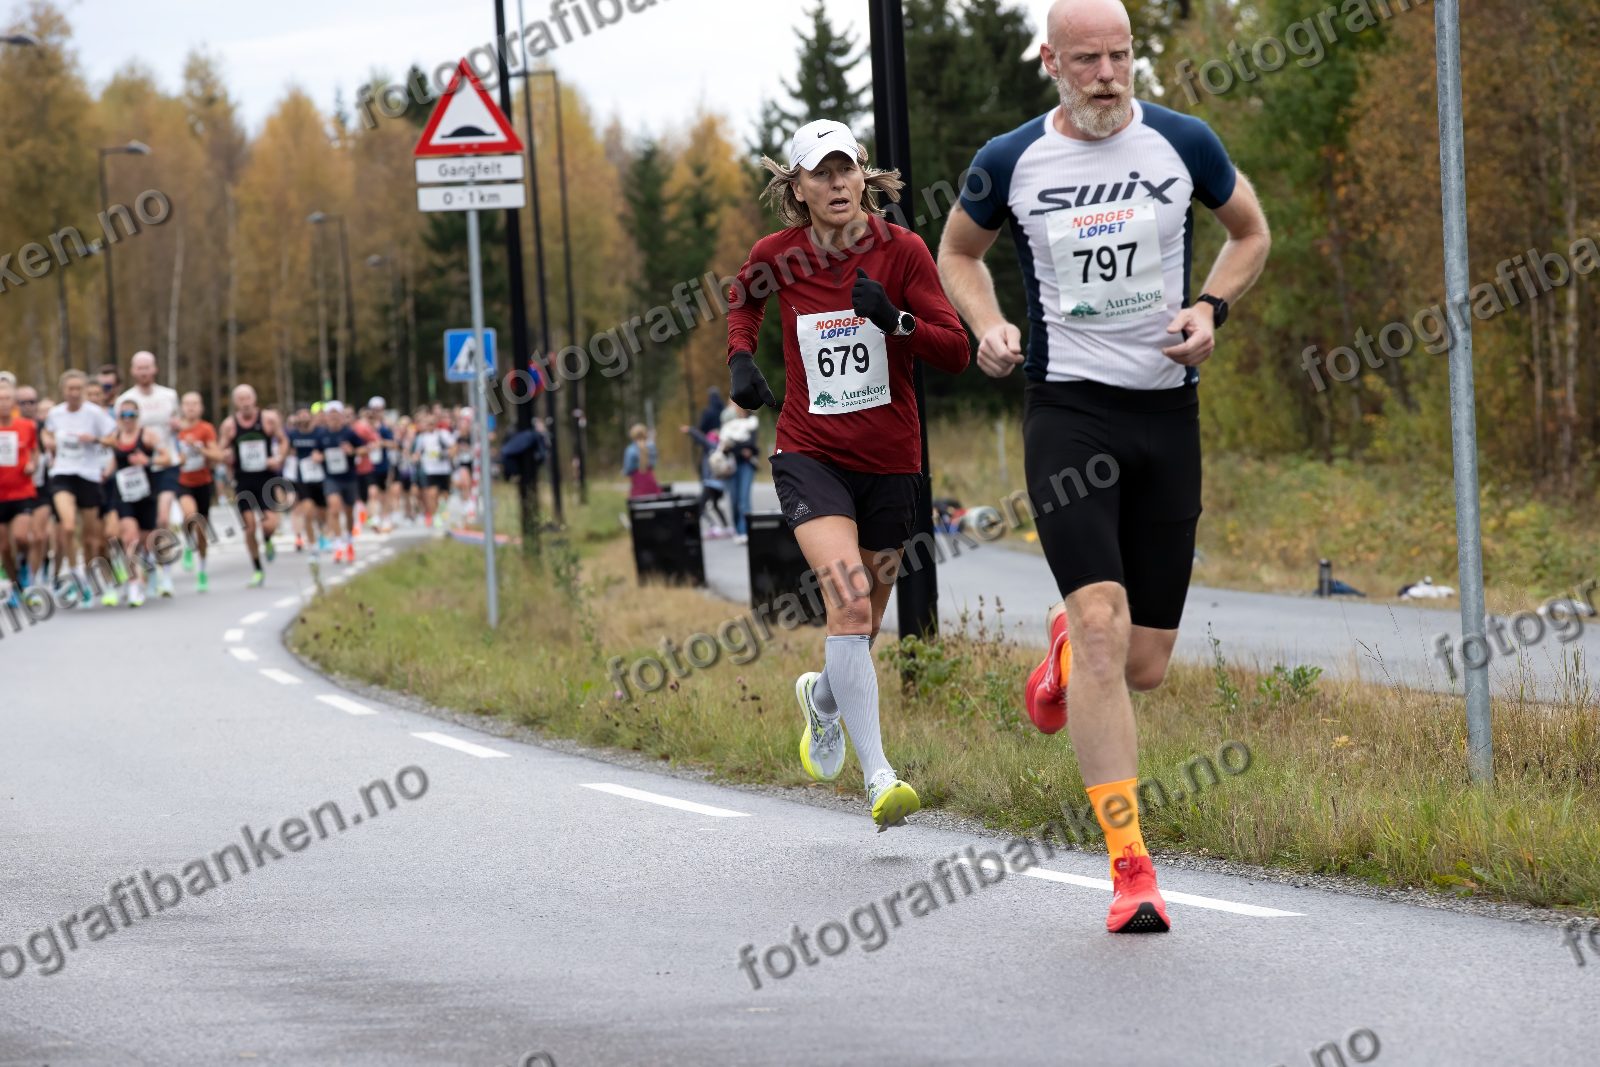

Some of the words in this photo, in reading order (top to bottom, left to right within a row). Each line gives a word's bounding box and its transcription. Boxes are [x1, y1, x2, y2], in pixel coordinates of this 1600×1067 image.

[438, 163, 503, 178] Gangfelt
[443, 192, 453, 205] 0
[468, 190, 474, 204] 1
[478, 189, 500, 203] km
[1072, 208, 1134, 229] NORGES
[1078, 221, 1126, 239] LØPET
[1073, 242, 1138, 284] 797
[1105, 289, 1162, 311] Aurskog
[1105, 304, 1153, 318] SPAREBANK
[815, 317, 867, 331] NORGES
[820, 326, 860, 340] LØPET
[817, 342, 870, 378] 679
[840, 384, 887, 401] Aurskog
